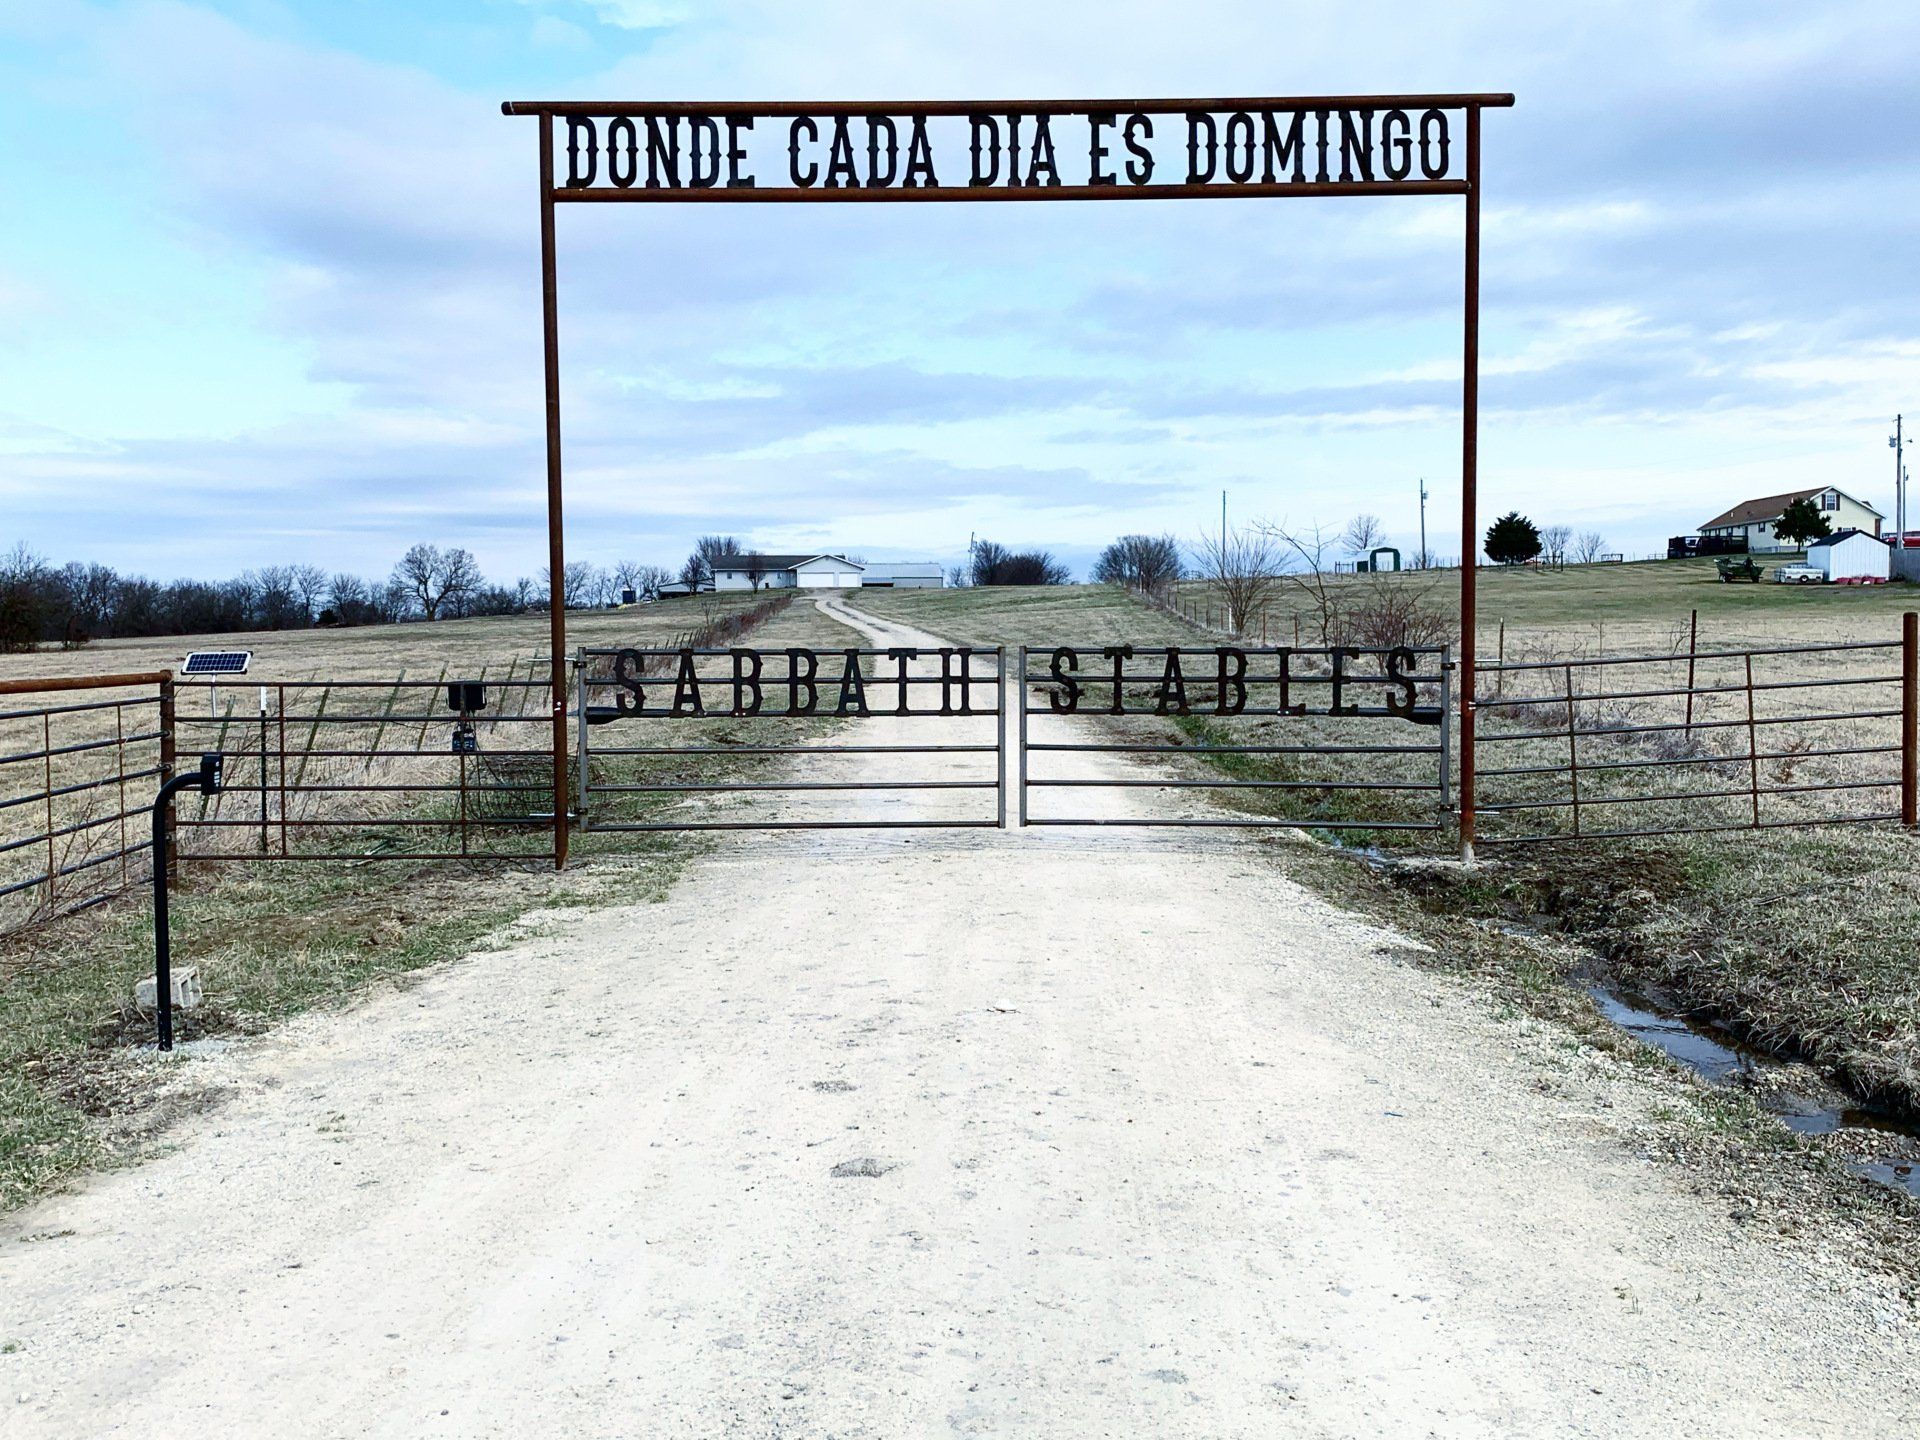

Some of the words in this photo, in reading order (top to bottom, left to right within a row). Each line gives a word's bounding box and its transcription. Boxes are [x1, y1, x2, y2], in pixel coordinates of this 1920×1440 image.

[566, 115, 755, 189] DONDE
[788, 115, 939, 188] CADA
[969, 114, 1061, 188] DIA
[1088, 113, 1155, 186] ES
[1185, 109, 1450, 185] DOMINGO
[613, 647, 973, 717] SABBATH
[1049, 646, 1418, 717] STABLES
